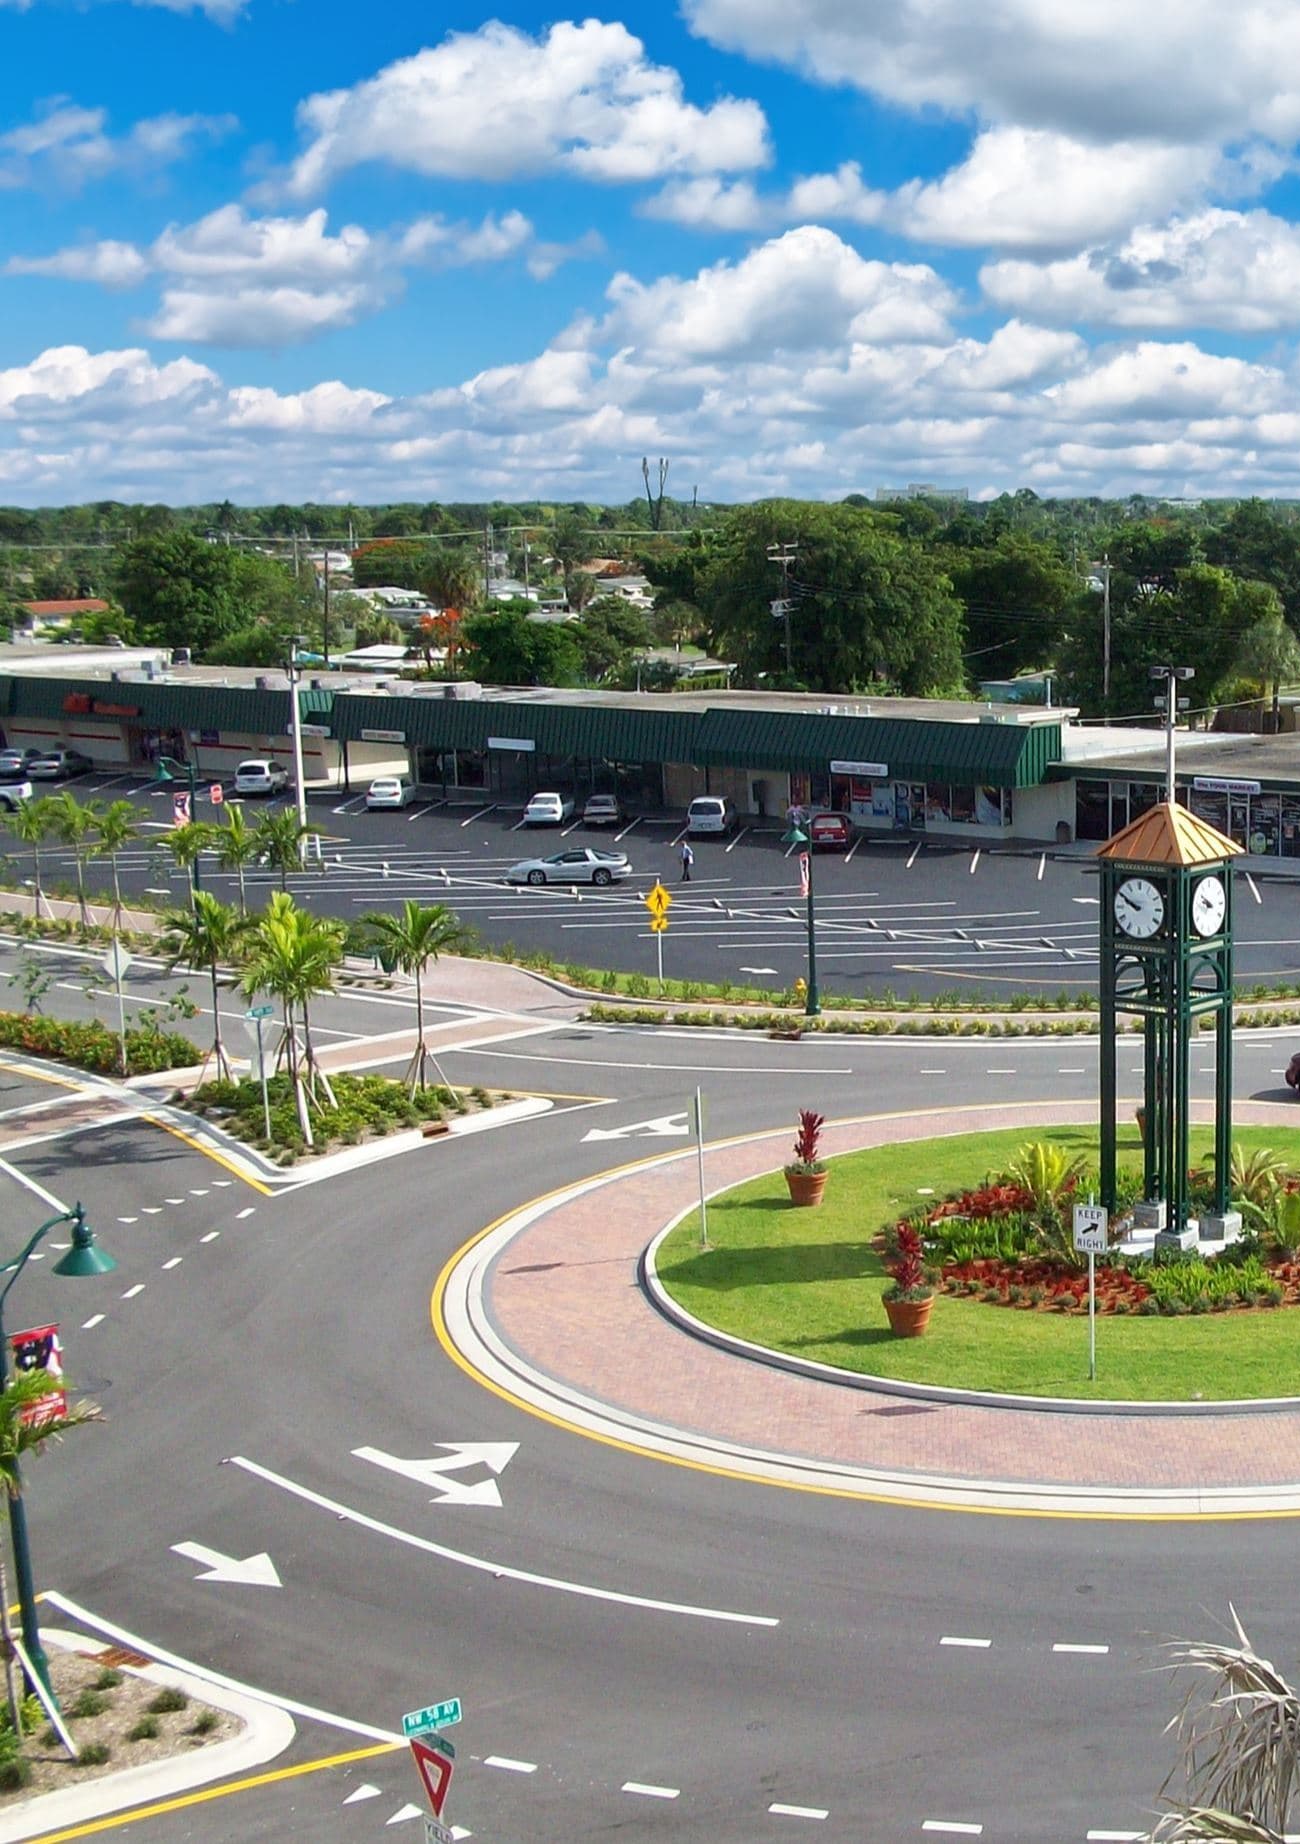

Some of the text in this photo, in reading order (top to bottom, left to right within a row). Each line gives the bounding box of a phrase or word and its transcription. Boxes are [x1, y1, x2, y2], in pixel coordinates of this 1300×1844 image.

[1078, 1209, 1103, 1220] KEEP
[1077, 1238, 1104, 1250] RIGHT
[408, 1711, 422, 1727] NW
[443, 1701, 456, 1717] AV
